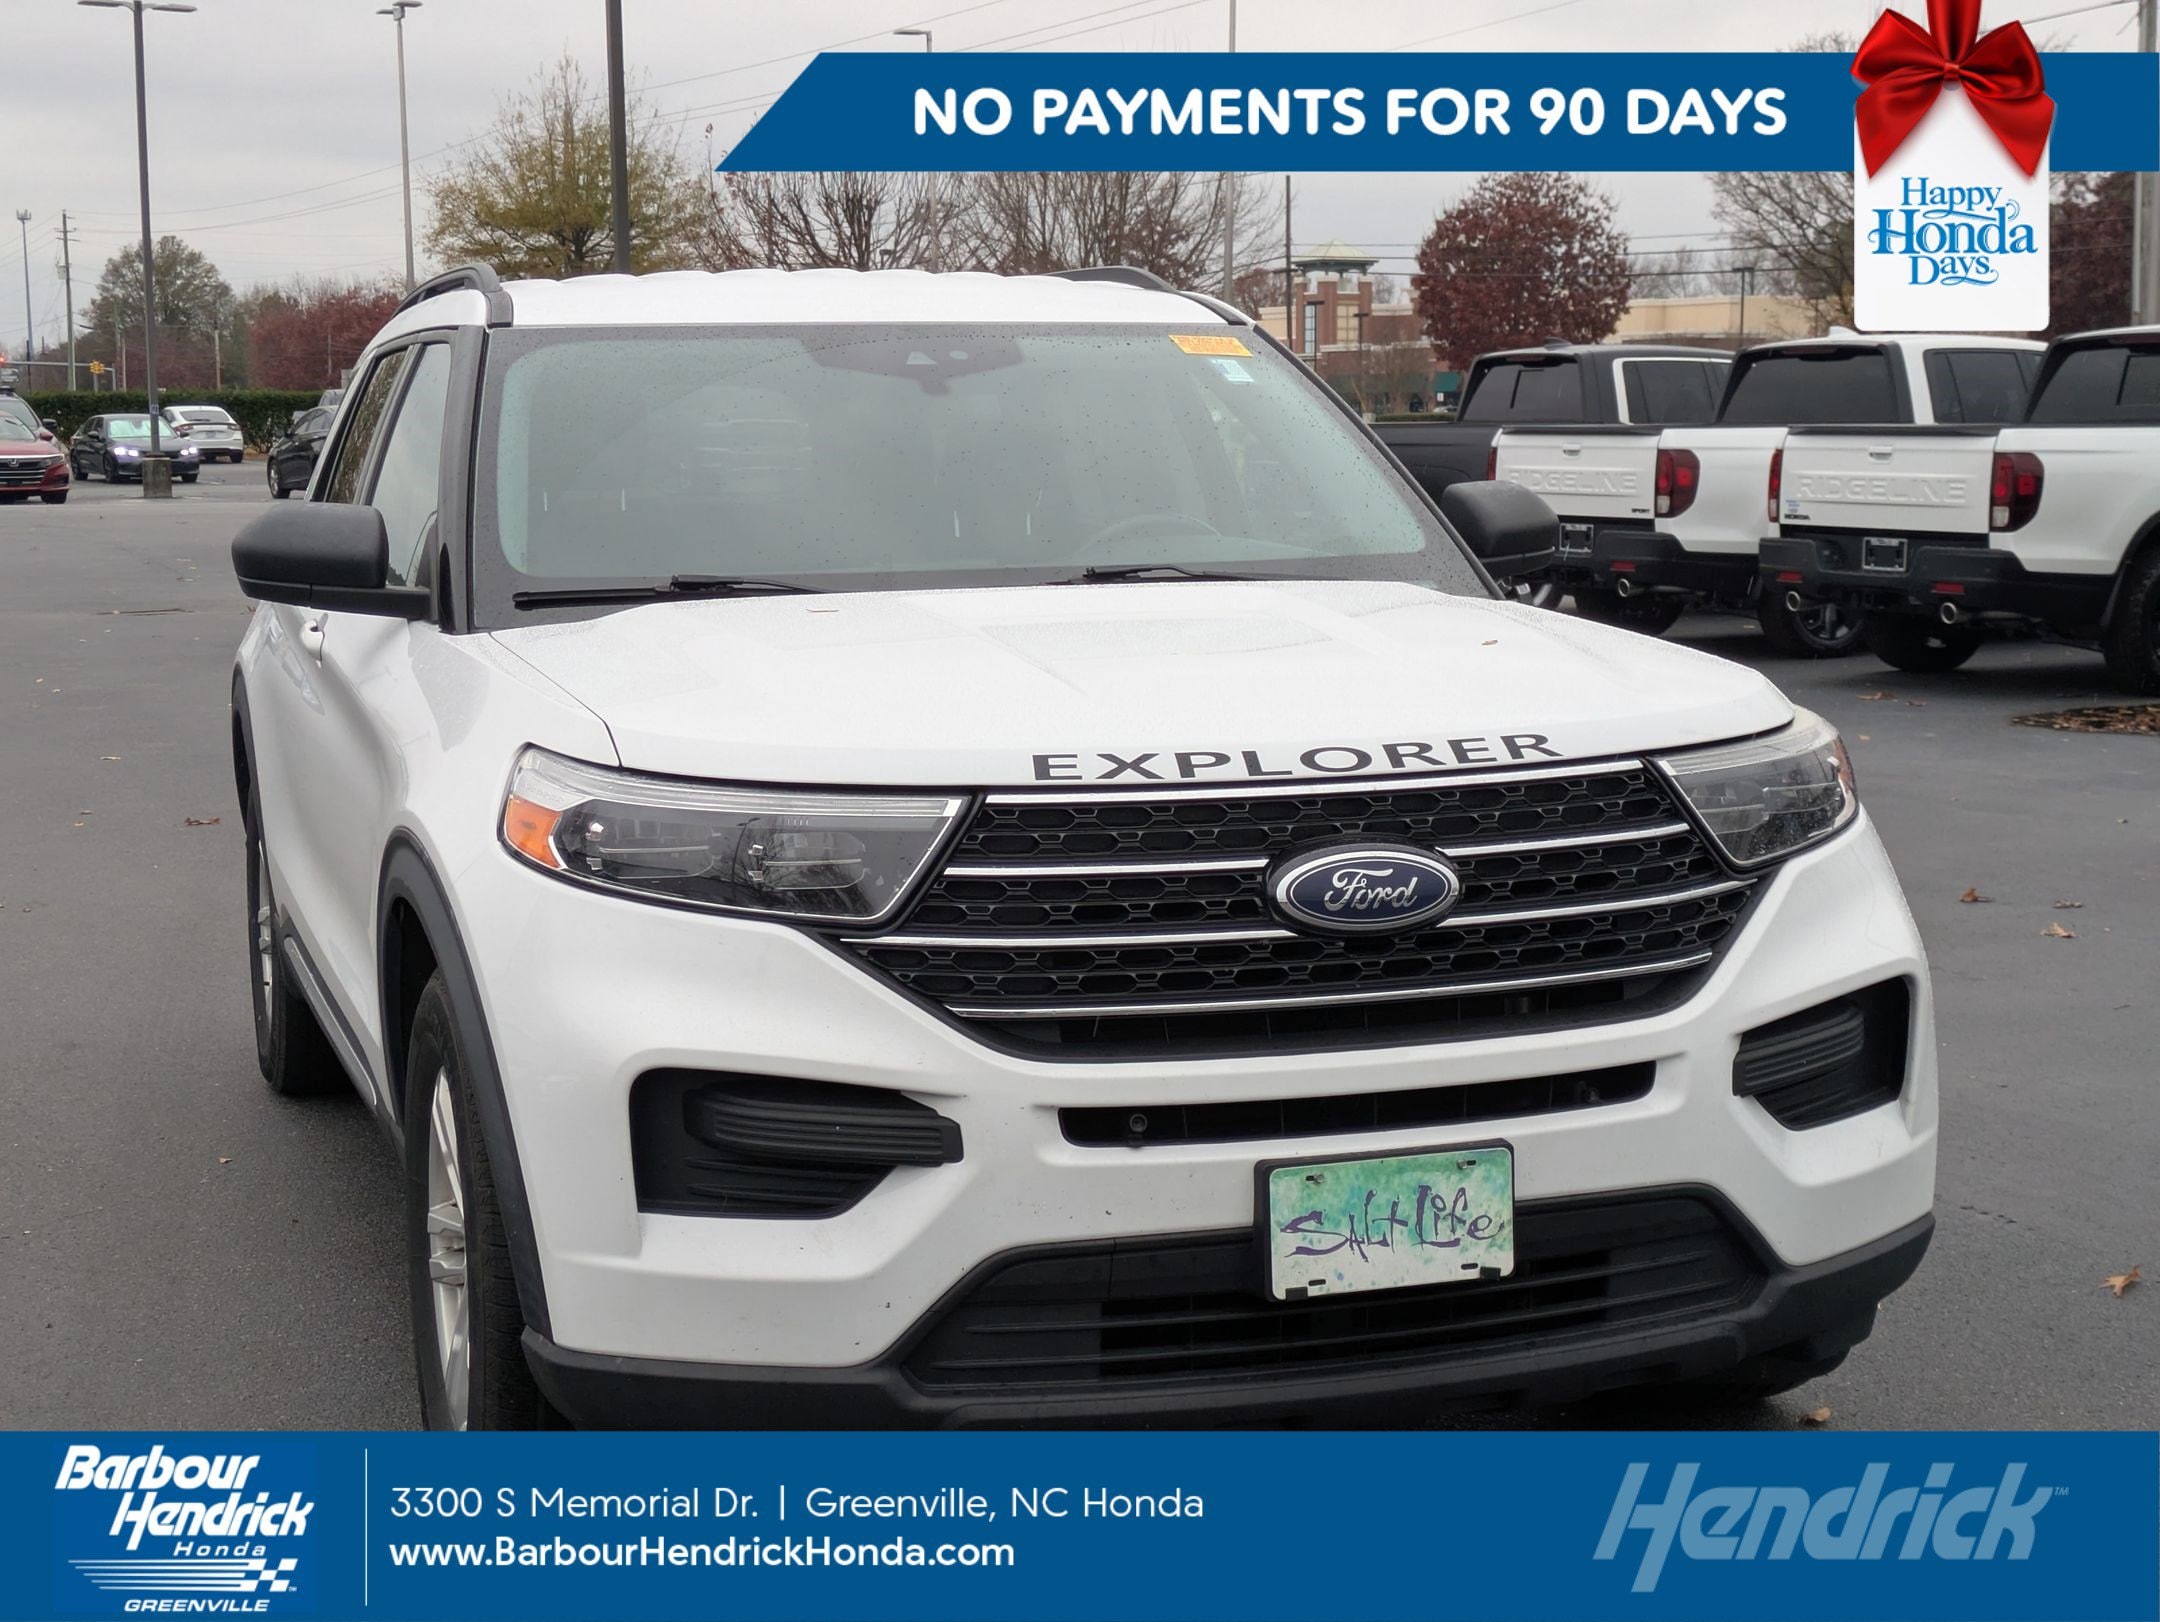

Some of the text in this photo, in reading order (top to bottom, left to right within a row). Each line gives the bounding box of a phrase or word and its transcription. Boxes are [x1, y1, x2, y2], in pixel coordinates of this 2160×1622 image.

[1797, 475, 1967, 503] RIDGELINE
[1031, 733, 1564, 781] EXPLORER
[1323, 867, 1419, 912] Ford
